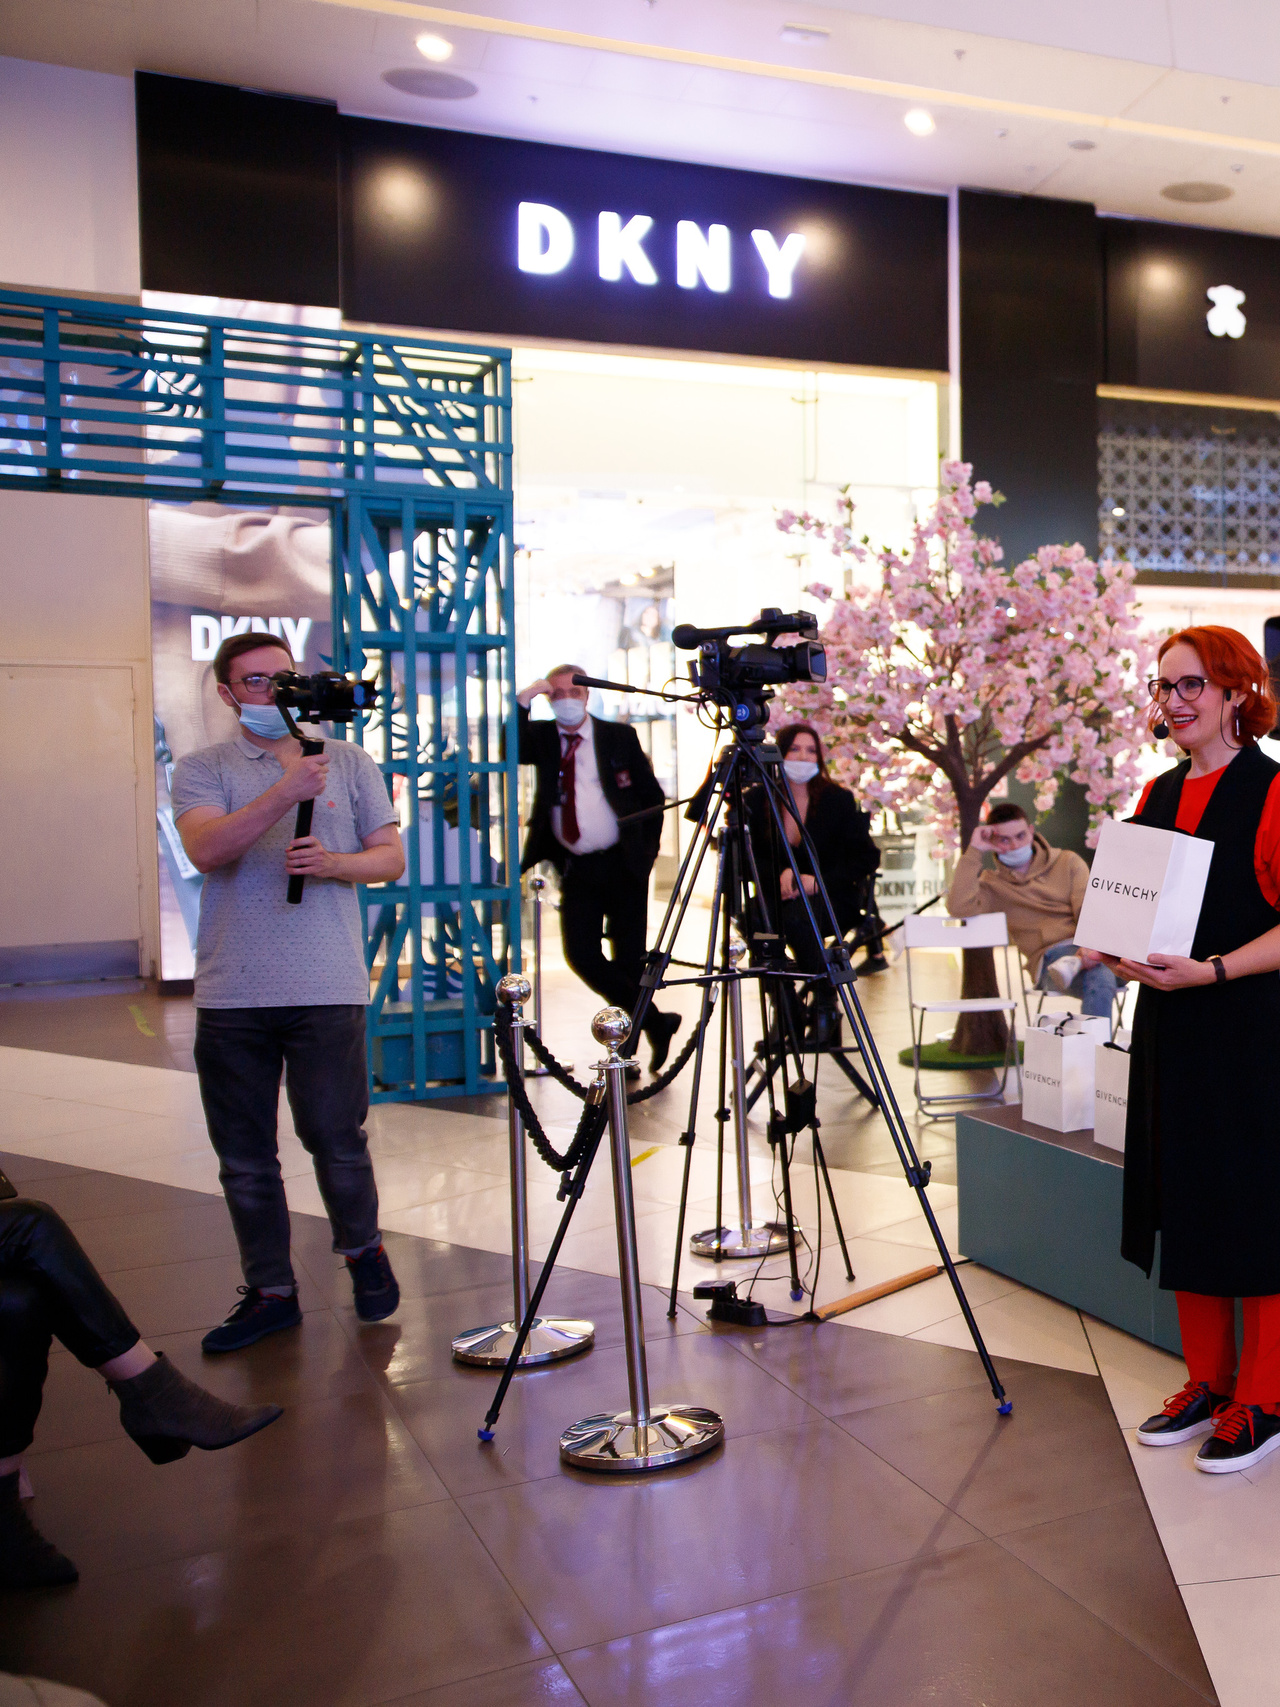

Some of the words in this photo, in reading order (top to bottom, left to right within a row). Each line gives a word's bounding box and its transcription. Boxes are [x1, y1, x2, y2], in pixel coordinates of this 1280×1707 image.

[517, 201, 806, 299] DKNY
[1091, 877, 1158, 902] GIVENCHY
[1024, 1070, 1061, 1088] GIVENCHY
[1095, 1089, 1128, 1107] GIVENCH
